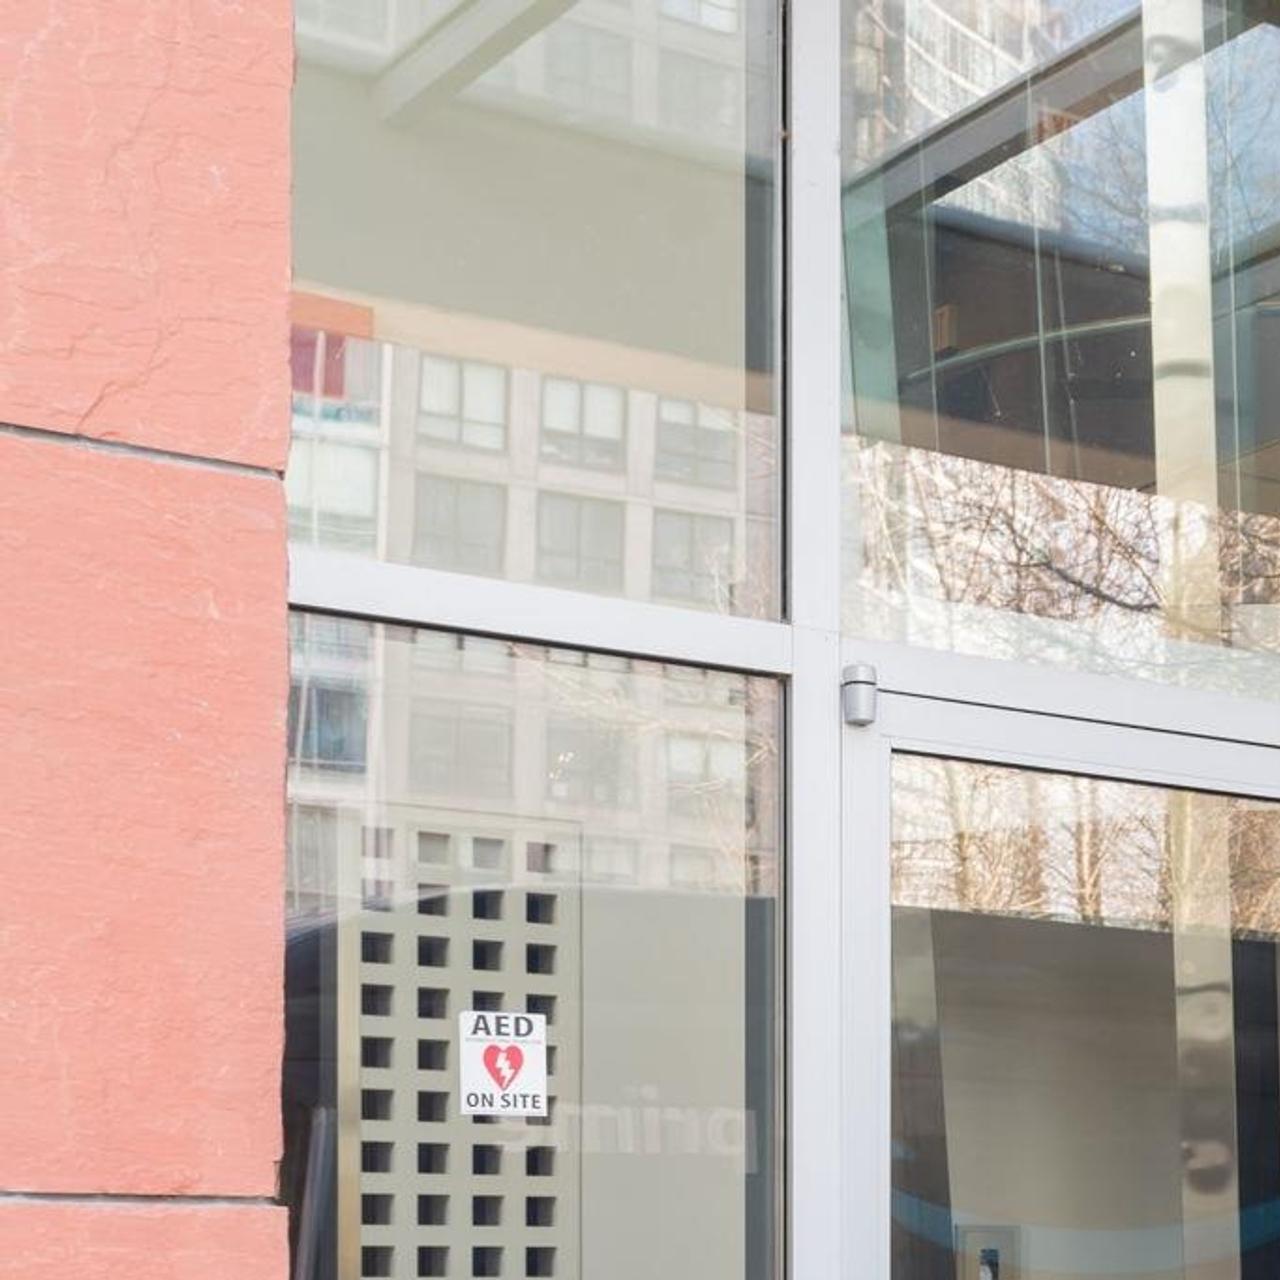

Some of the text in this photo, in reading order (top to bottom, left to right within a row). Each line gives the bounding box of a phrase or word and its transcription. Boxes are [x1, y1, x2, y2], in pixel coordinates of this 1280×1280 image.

[471, 1014, 533, 1037] AED
[466, 1092, 541, 1109] ON SITE
